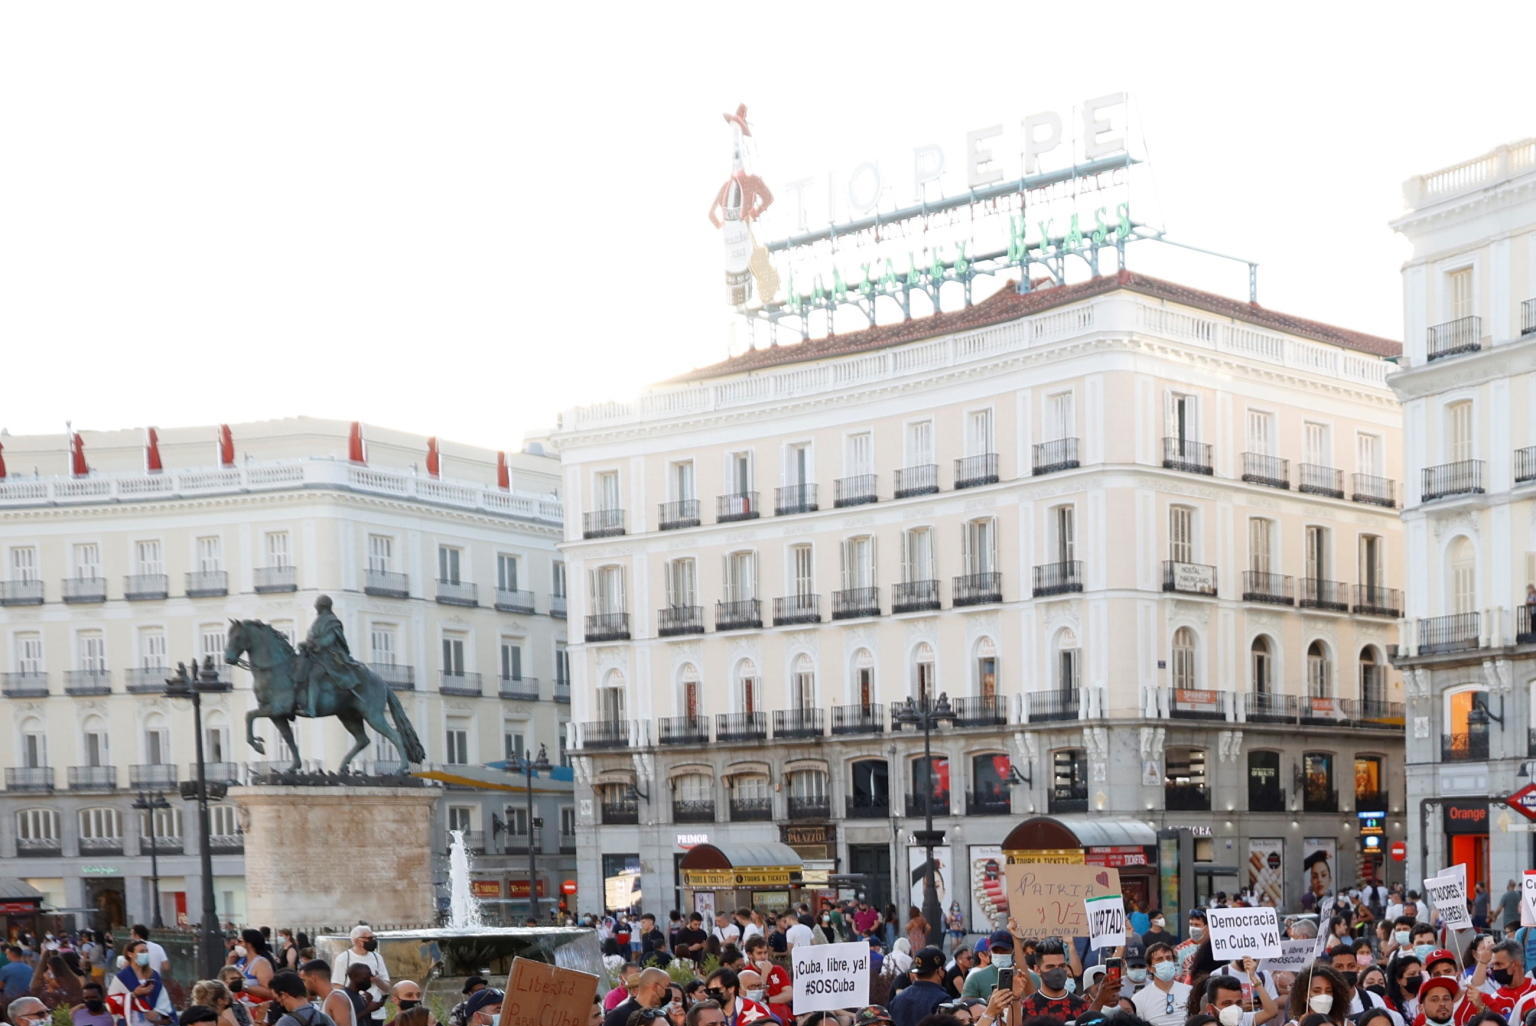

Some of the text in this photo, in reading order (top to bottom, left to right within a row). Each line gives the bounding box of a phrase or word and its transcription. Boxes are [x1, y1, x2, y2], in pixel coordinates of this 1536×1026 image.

[785, 160, 881, 232] TIO
[912, 91, 1128, 202] PEPE
[1450, 807, 1486, 822] Orange
[677, 833, 708, 844] PRIMOR
[743, 874, 759, 883] TOURS
[767, 874, 789, 882] TICKETS
[1015, 871, 1095, 898] PATRIA
[1531, 897, 1536, 907] y
[1210, 911, 1276, 929] Democracia
[1019, 928, 1048, 938] VIVA
[1214, 934, 1279, 950] en Cuba, YA!
[795, 956, 867, 980] ¡Cuba, libre, ya!
[805, 978, 855, 997] #SOSCuba
